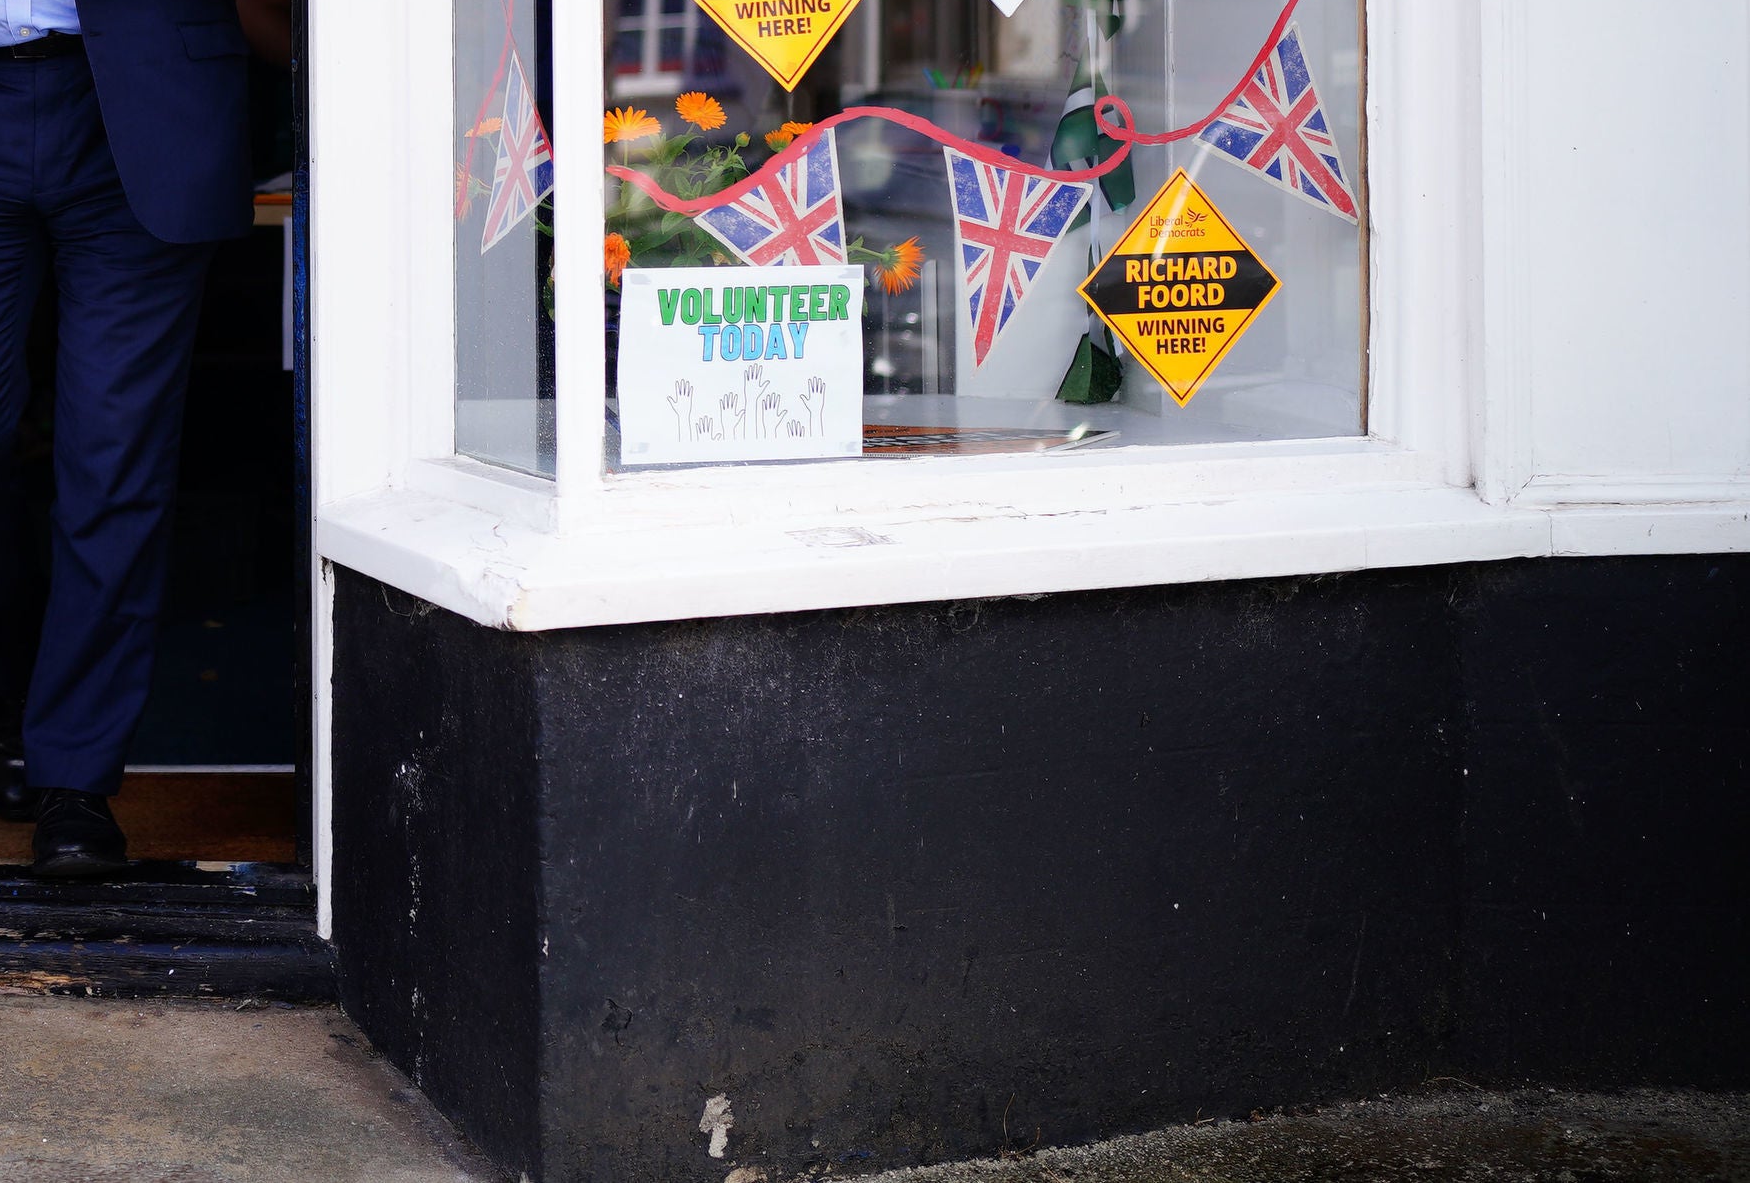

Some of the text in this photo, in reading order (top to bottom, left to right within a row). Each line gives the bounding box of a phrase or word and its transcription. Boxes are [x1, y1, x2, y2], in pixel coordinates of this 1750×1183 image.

[757, 16, 812, 38] HERE!
[1149, 215, 1185, 229] Liberal
[1149, 226, 1206, 239] Democrats
[1125, 255, 1237, 285] RICHARD
[657, 284, 850, 326] VOLUNTEER
[1137, 282, 1225, 311] FOORD
[1135, 318, 1225, 338] WINNING
[699, 322, 810, 363] TODAY
[1155, 337, 1207, 356] HERE!
